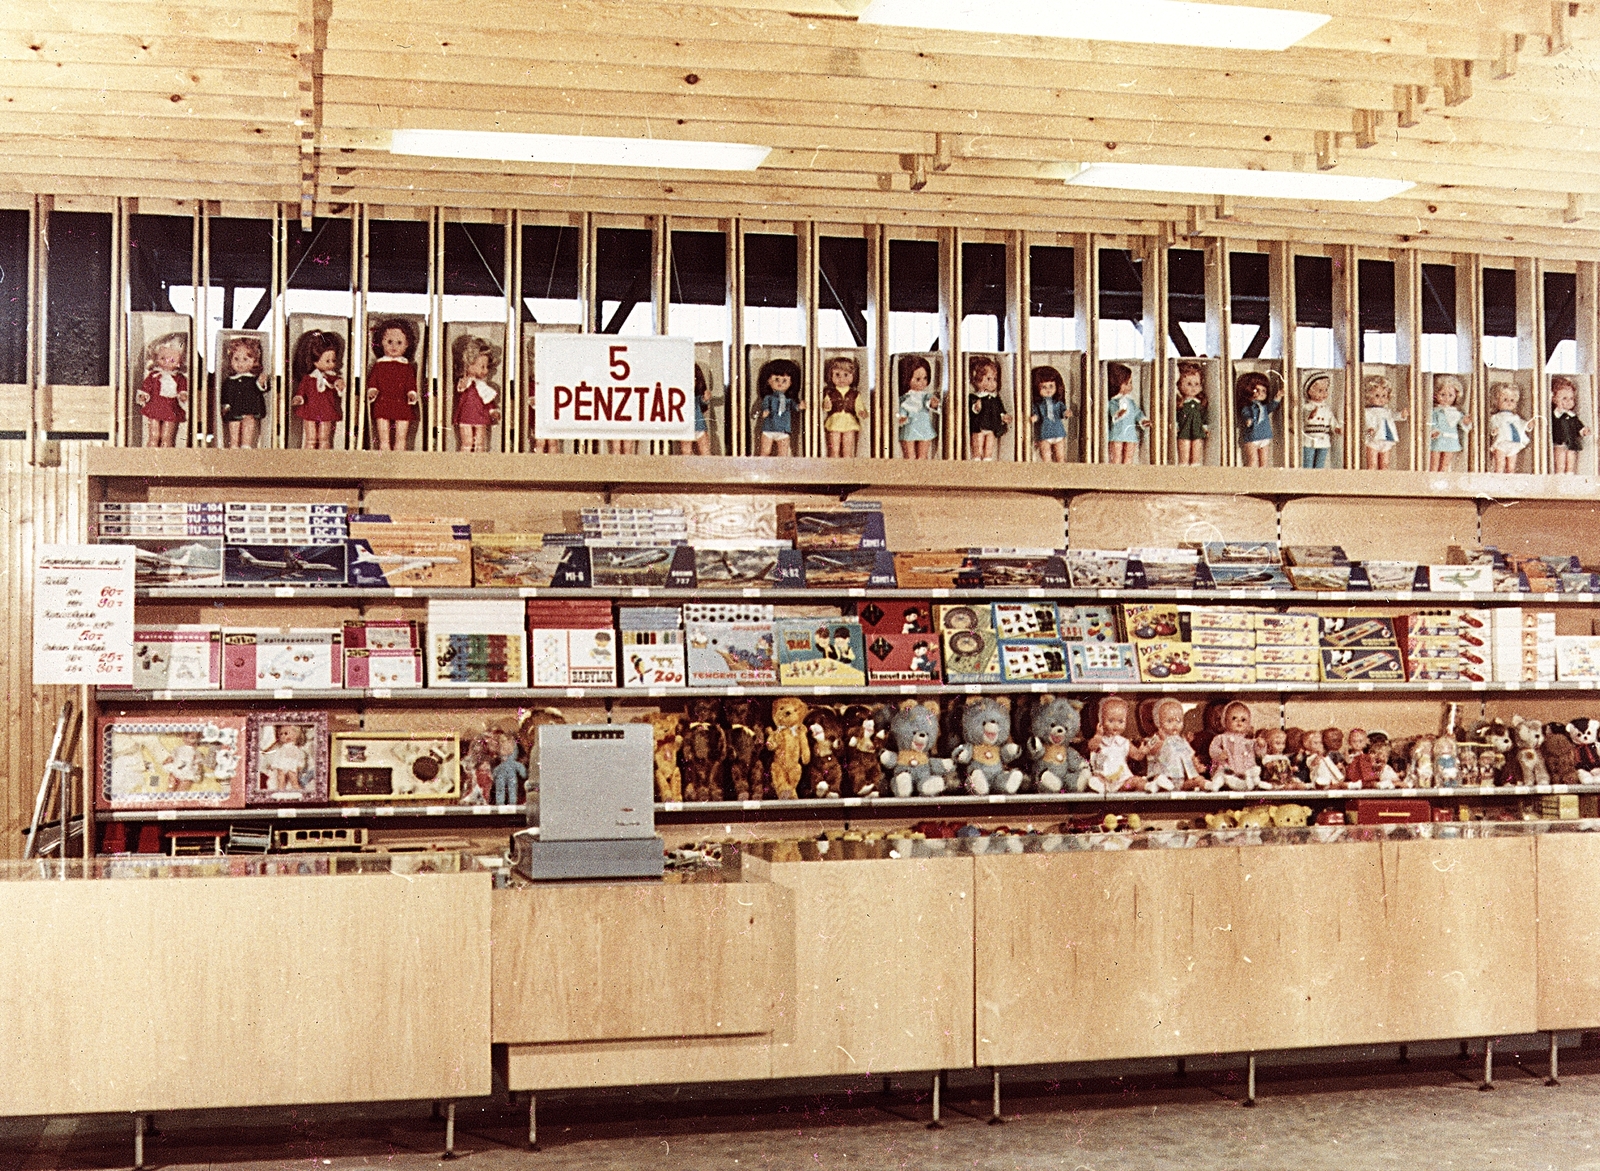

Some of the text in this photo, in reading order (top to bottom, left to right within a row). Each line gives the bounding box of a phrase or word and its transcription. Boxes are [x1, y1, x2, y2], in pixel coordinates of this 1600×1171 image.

[609, 345, 631, 382] 5
[553, 380, 687, 423] PÉNZTÁR
[188, 503, 224, 512] TU-104
[188, 514, 224, 523] TU-104
[188, 525, 224, 535] TU-104
